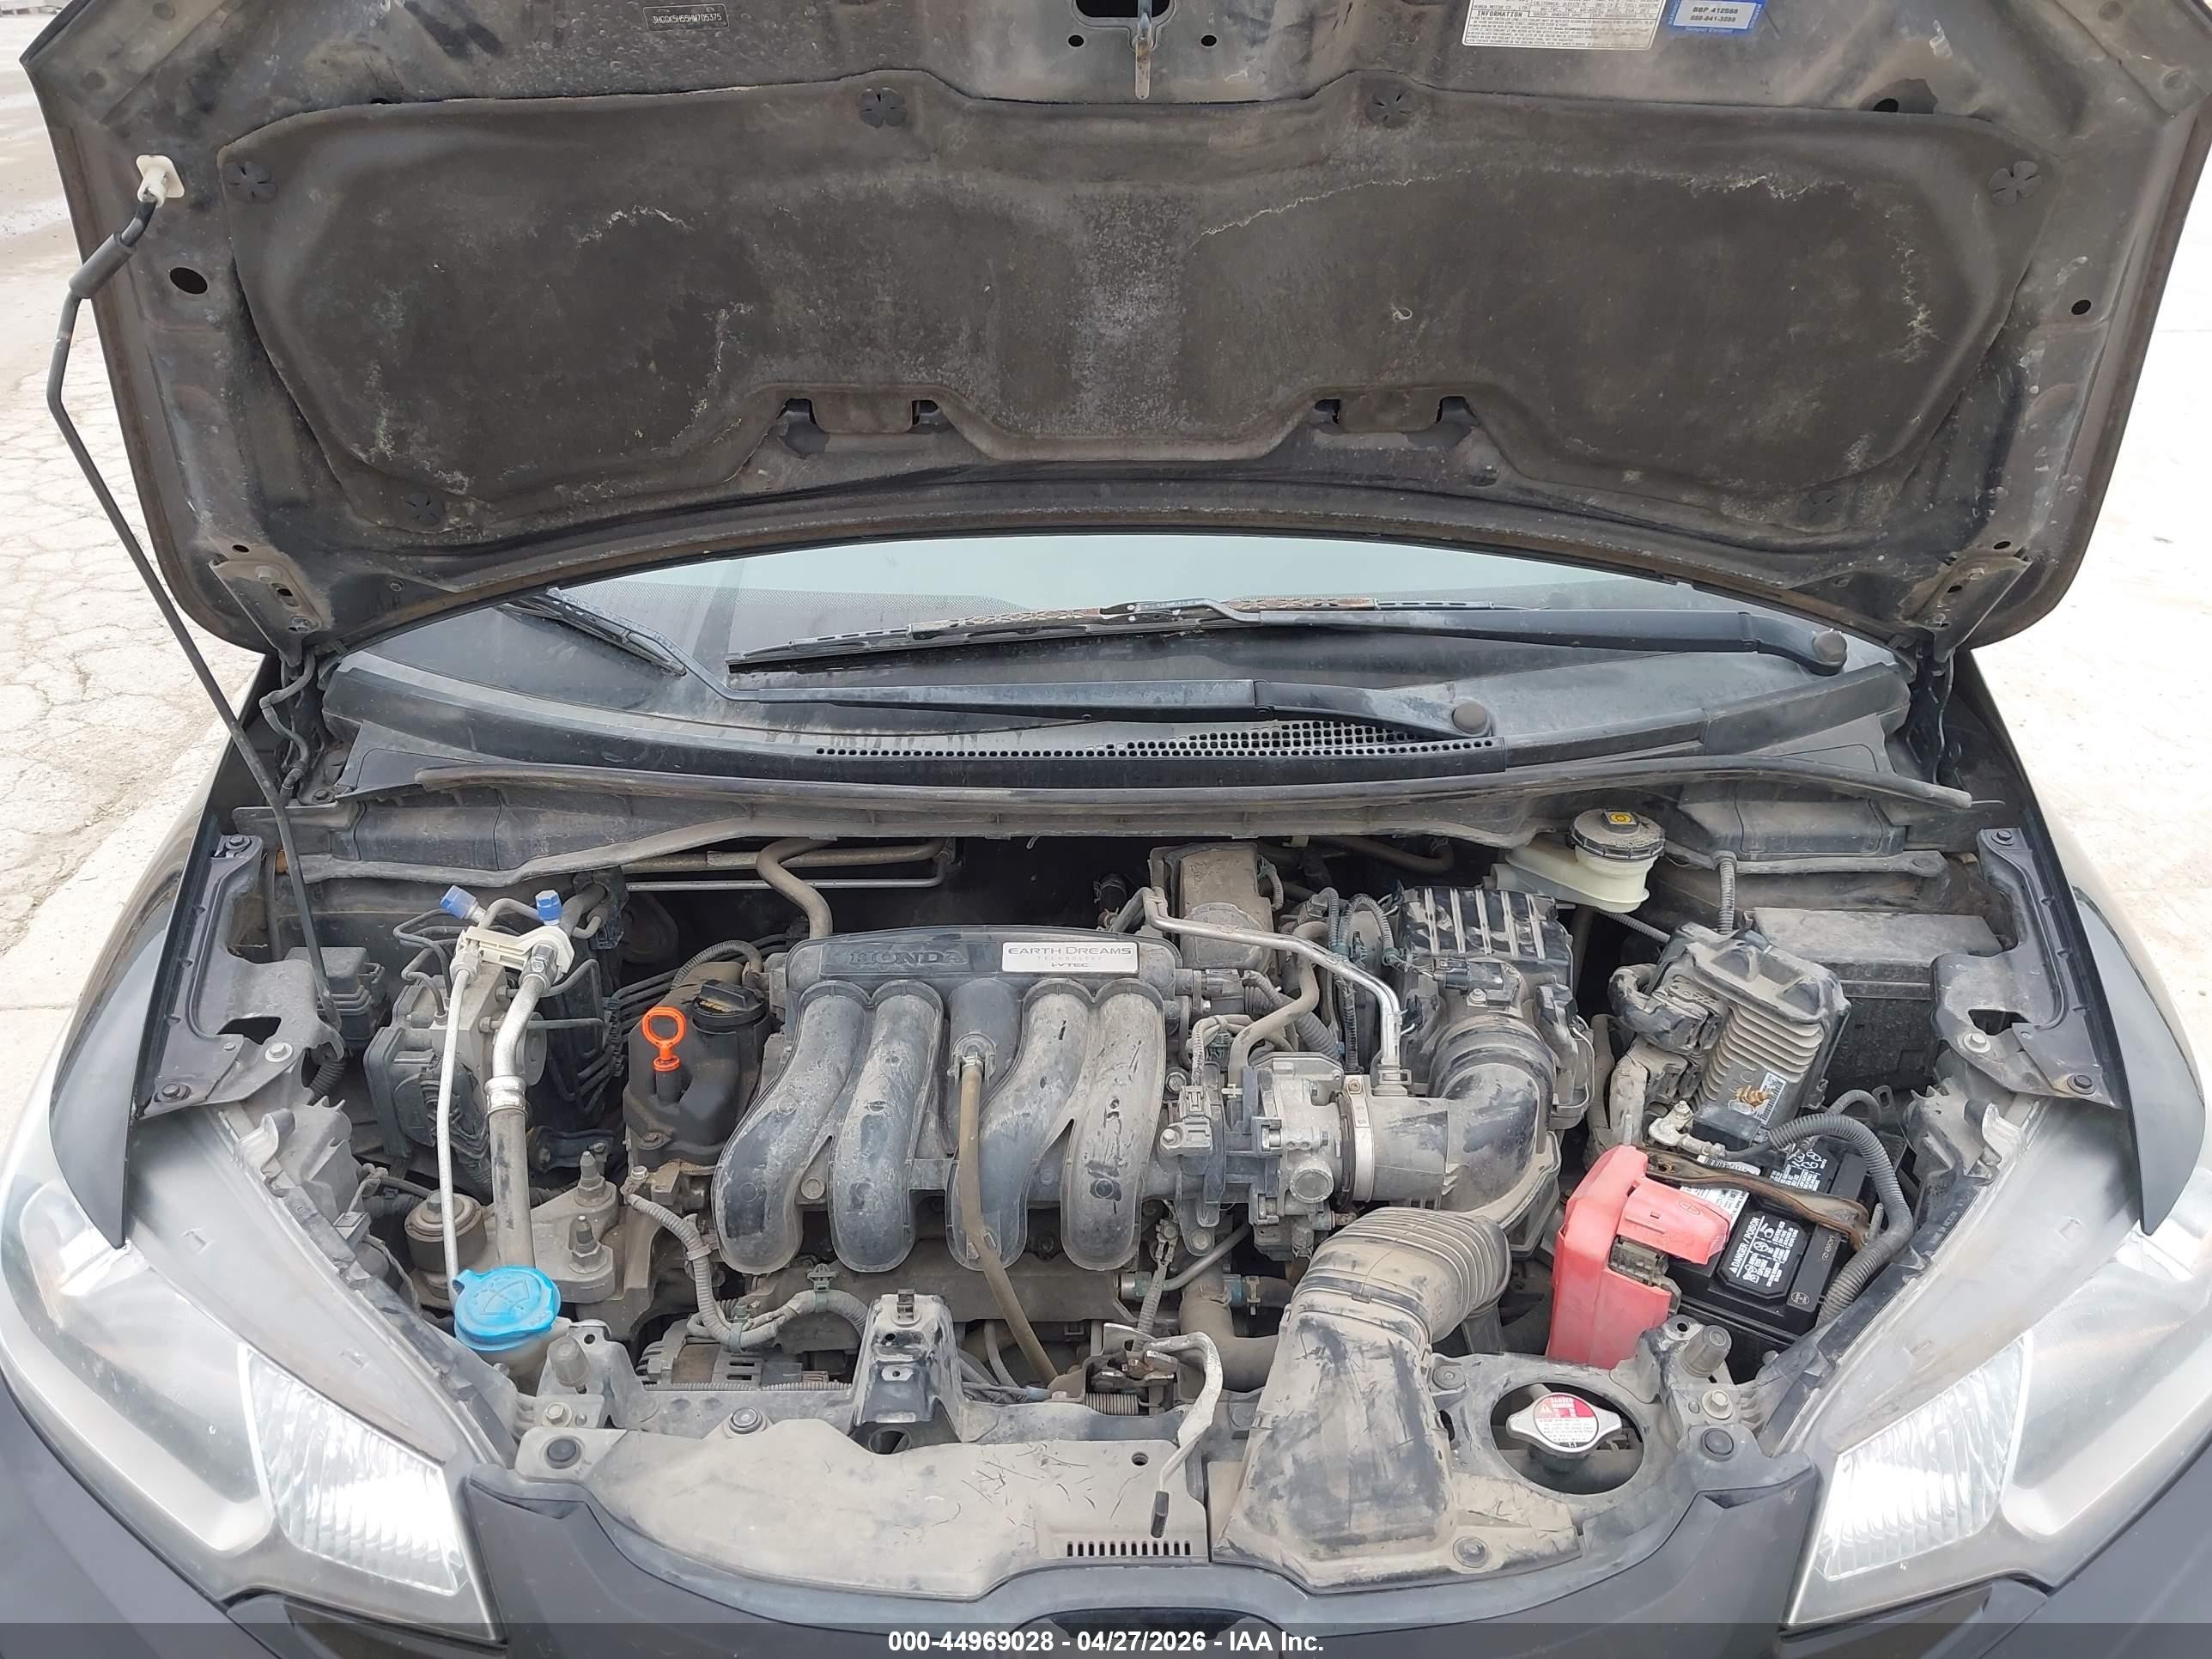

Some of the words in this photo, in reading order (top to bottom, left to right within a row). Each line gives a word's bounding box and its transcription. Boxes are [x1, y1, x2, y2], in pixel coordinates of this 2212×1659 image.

[850, 951, 968, 965] HONDA
[1731, 1243, 1748, 1267] DANGER
[1744, 1217, 1760, 1239] POISON
